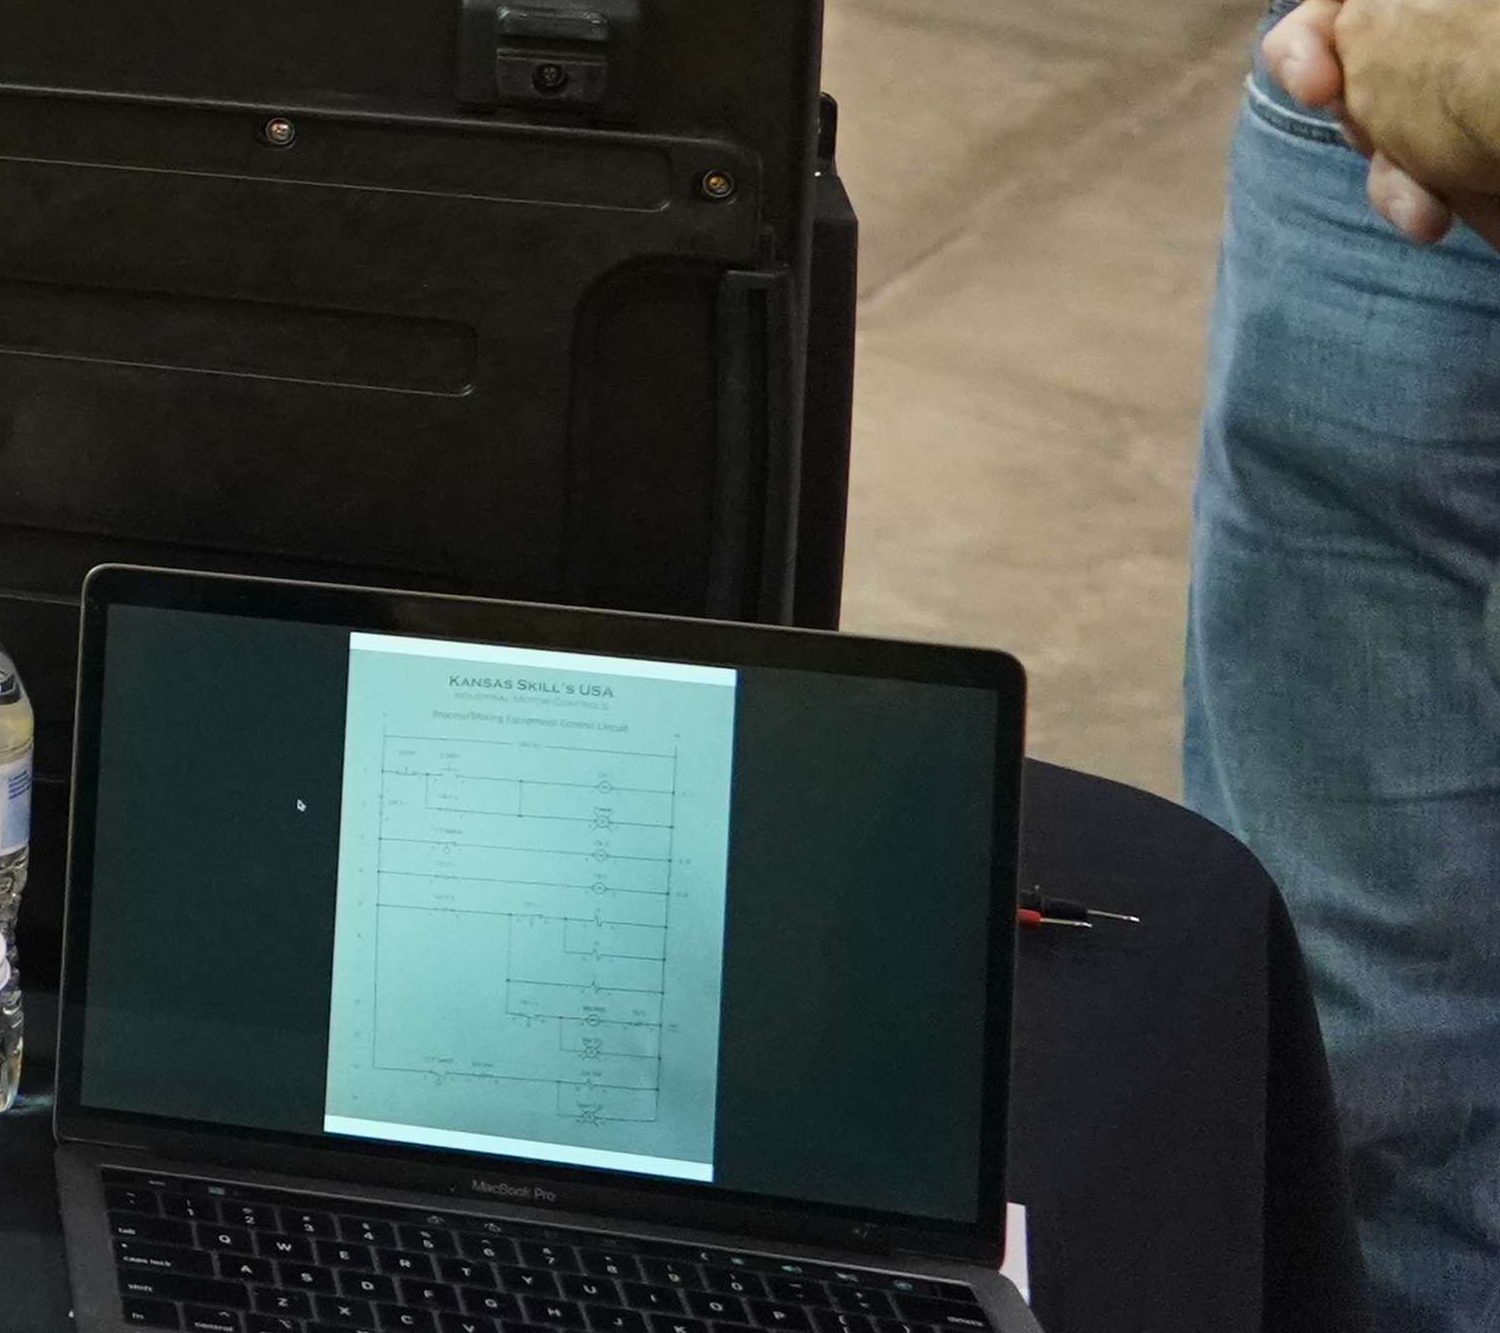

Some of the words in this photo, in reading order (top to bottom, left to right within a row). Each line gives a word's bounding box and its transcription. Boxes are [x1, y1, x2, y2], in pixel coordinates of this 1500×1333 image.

[579, 683, 615, 699] USA
[471, 1179, 531, 1198] MacBook
[533, 1186, 557, 1203] Pro
[218, 1234, 232, 1245] Q
[275, 1241, 293, 1252] W
[339, 1250, 350, 1261] E
[399, 1258, 412, 1269] R
[240, 1264, 253, 1275] A
[300, 1271, 314, 1283] S
[521, 1275, 534, 1285] Y
[361, 1280, 375, 1291] D
[583, 1284, 598, 1295] U
[277, 1297, 289, 1308] Z
[709, 1301, 724, 1312] O
[338, 1305, 352, 1317] X
[547, 1307, 562, 1318] H
[399, 1314, 414, 1326] C
[462, 1322, 476, 1333] V
